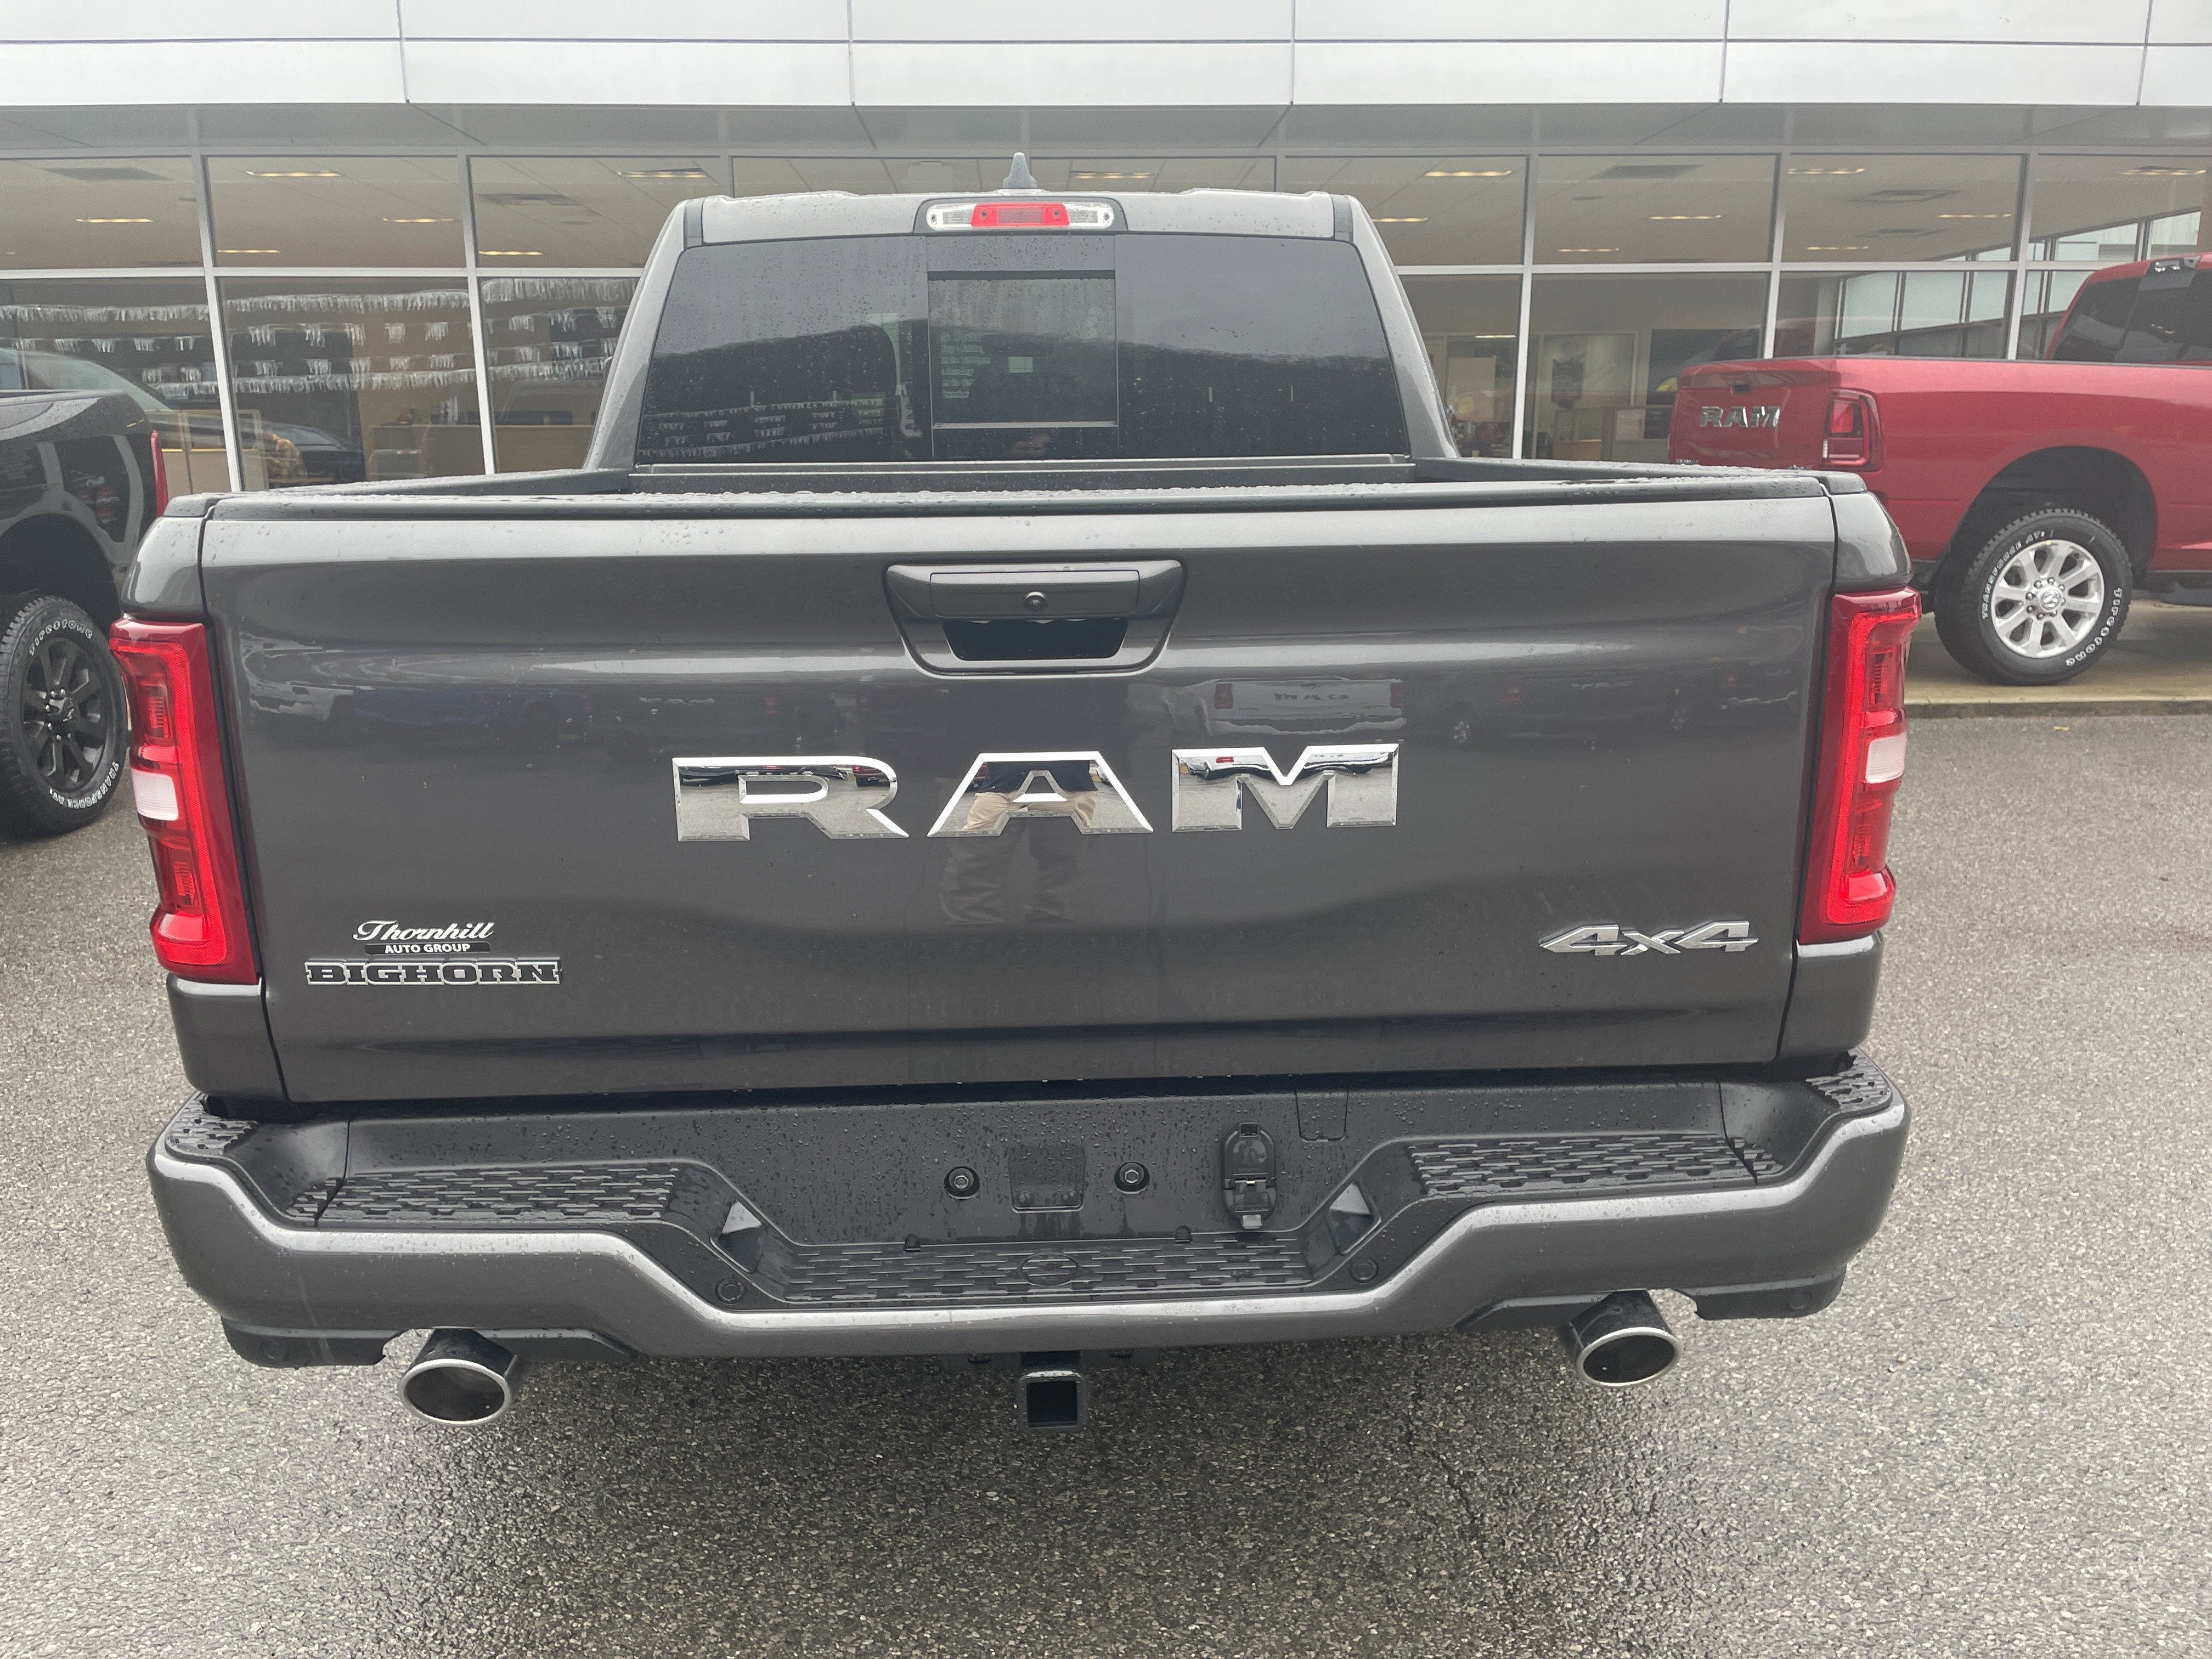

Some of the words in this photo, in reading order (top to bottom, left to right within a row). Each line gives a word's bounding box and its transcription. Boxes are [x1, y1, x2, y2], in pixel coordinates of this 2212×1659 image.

[1699, 405, 1781, 428] RAM
[672, 743, 1400, 842] RAM
[352, 919, 495, 941] Thornhill
[384, 944, 422, 954] AUTO
[423, 943, 471, 953] GROUP
[304, 960, 562, 985] BIGHORN
